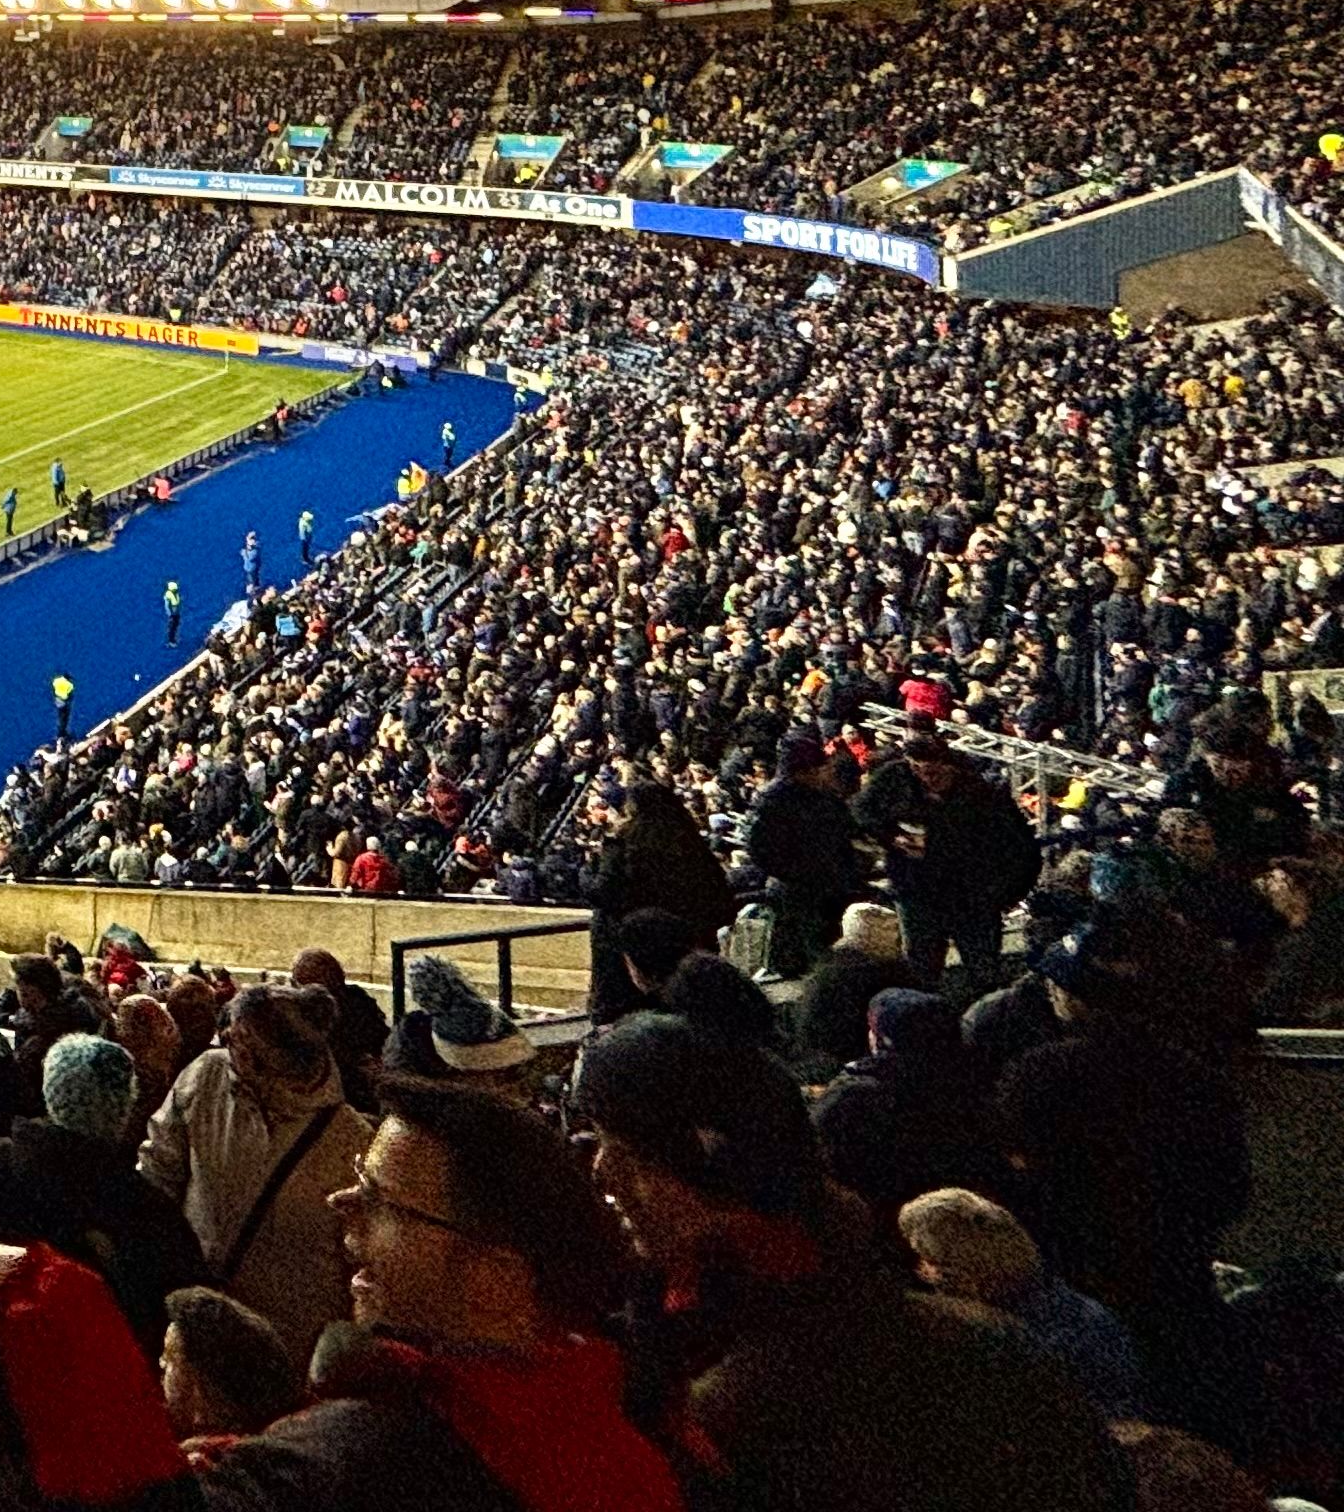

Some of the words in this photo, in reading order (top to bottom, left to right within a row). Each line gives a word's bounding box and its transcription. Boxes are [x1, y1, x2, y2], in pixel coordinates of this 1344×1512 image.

[334, 181, 491, 210] MALCOLM
[529, 194, 561, 213] As
[565, 196, 618, 219] One
[743, 215, 834, 252] SPORT
[836, 228, 881, 261] FOR
[882, 236, 919, 273] LIFE
[136, 323, 200, 348] LAGER
